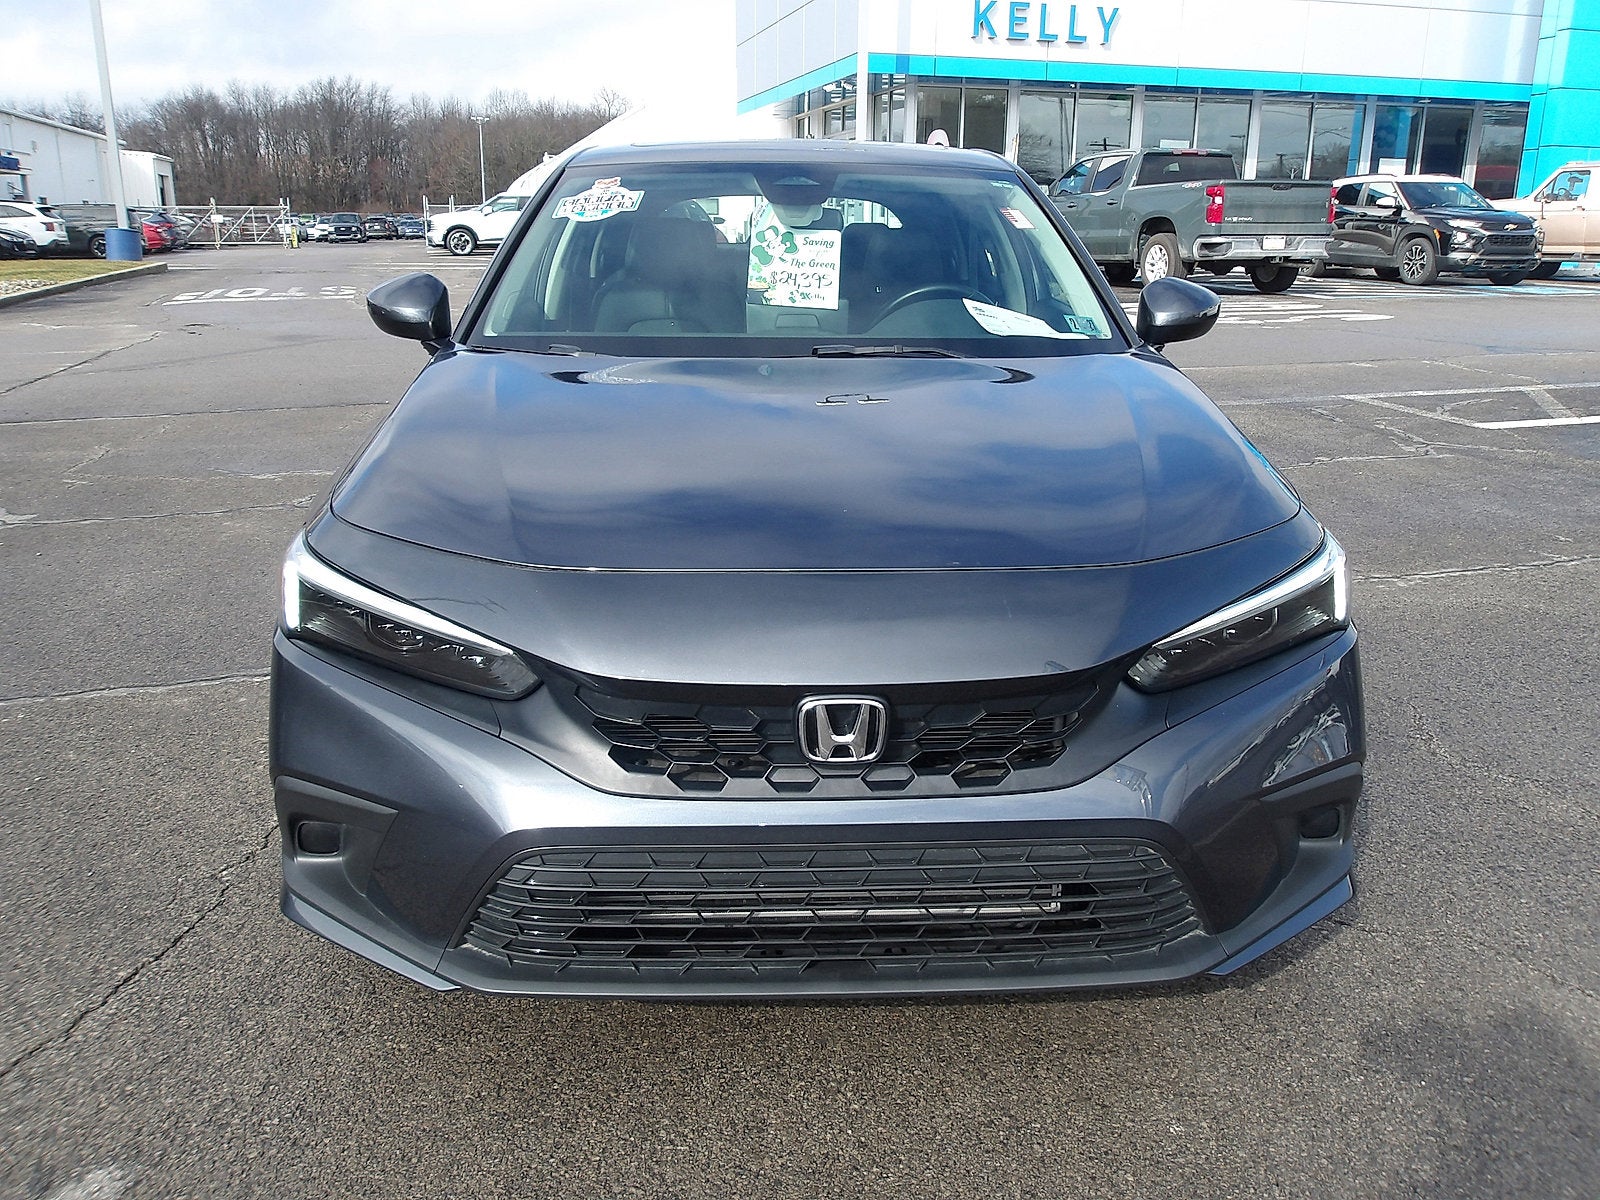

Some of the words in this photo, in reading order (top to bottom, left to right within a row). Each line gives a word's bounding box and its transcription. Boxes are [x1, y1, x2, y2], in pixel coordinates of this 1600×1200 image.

[972, 0, 1120, 45] KELLY
[803, 236, 835, 249] Saving
[790, 258, 806, 269] The
[808, 258, 837, 271] Green
[171, 286, 357, 300] STOP
